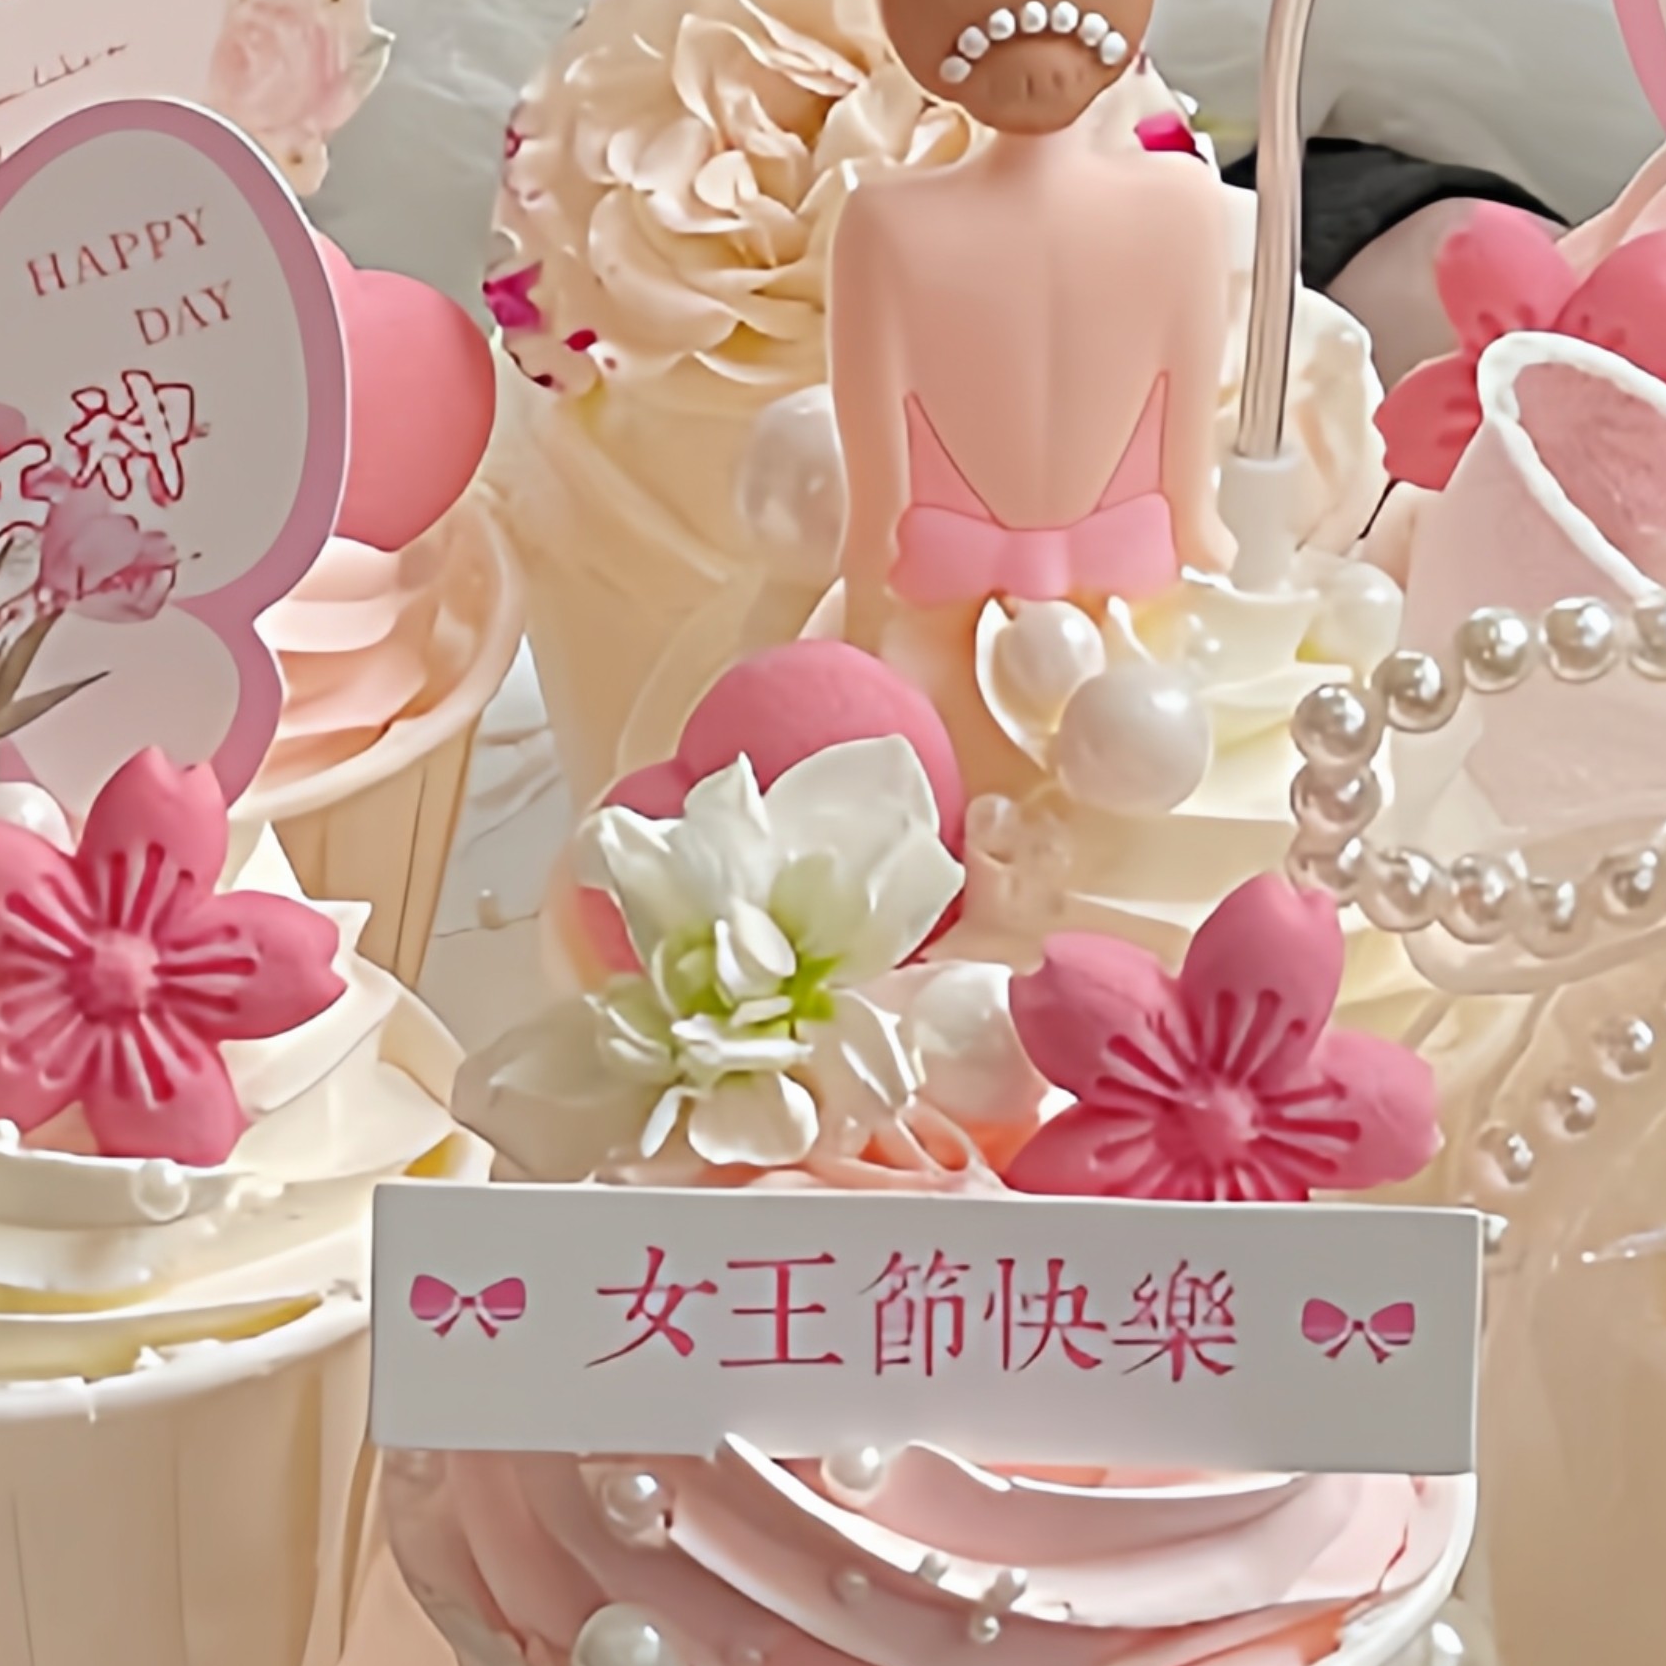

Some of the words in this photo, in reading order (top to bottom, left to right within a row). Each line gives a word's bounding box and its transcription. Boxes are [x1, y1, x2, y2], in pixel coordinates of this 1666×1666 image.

[27, 206, 211, 298] HAPPY
[134, 280, 238, 347] DAY
[584, 1245, 1237, 1383] 女王節快樂
